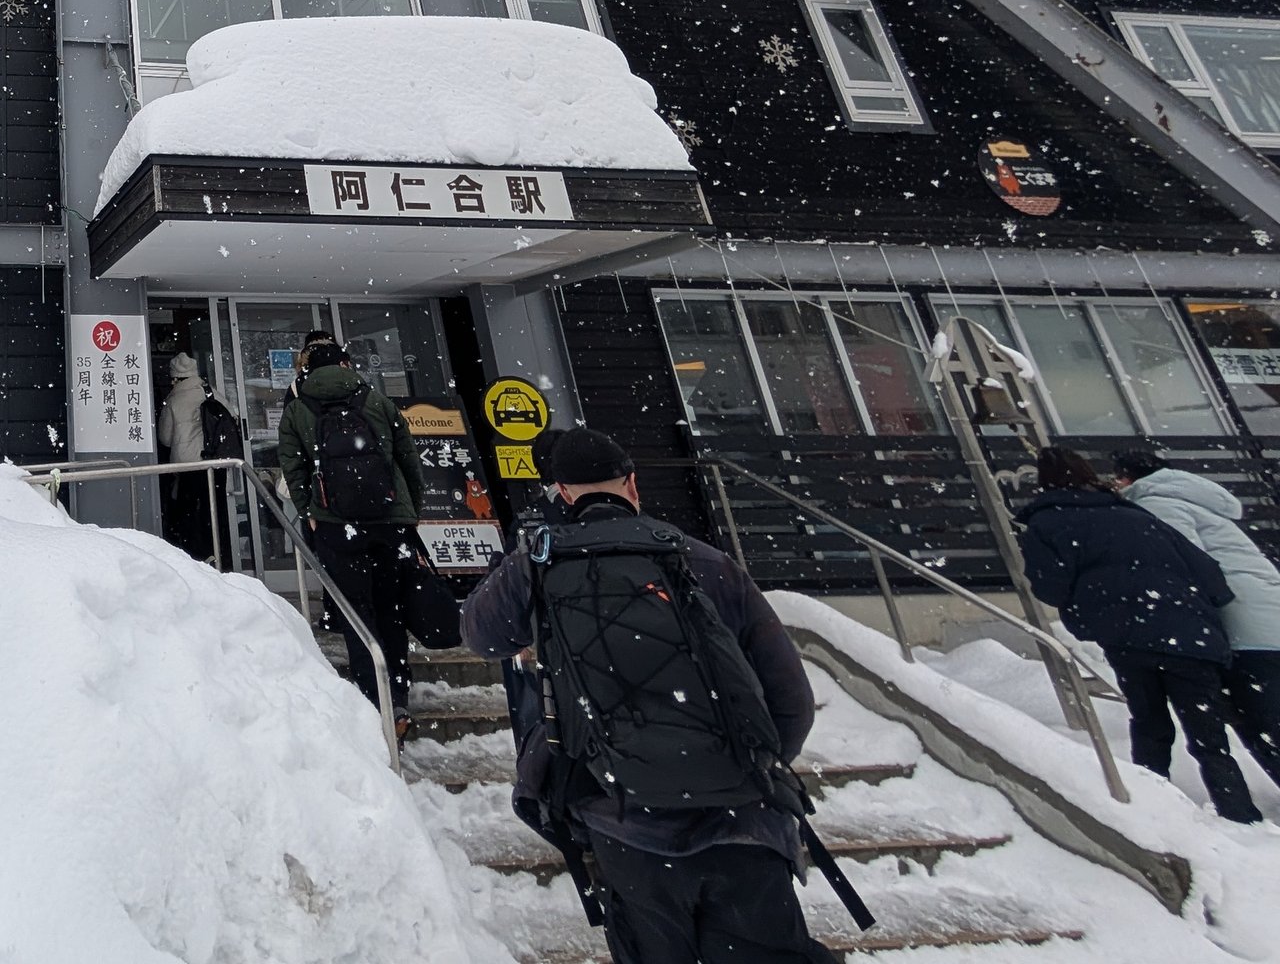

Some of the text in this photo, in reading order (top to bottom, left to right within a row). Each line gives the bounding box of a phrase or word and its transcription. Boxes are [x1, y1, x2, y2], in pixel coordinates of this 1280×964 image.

[331, 170, 546, 215] 阿仁合駅
[96, 327, 117, 346] 祝
[1213, 353, 1280, 377] 落雪注
[77, 357, 93, 406] 35周年
[100, 353, 118, 424] 全線開業
[124, 353, 144, 442] 秋田内陸線
[420, 447, 472, 468] ぐま亭
[498, 448, 531, 456] SIGHTSE
[500, 457, 539, 475] TA
[443, 527, 476, 538] OPEN
[431, 540, 494, 564] 営業中
